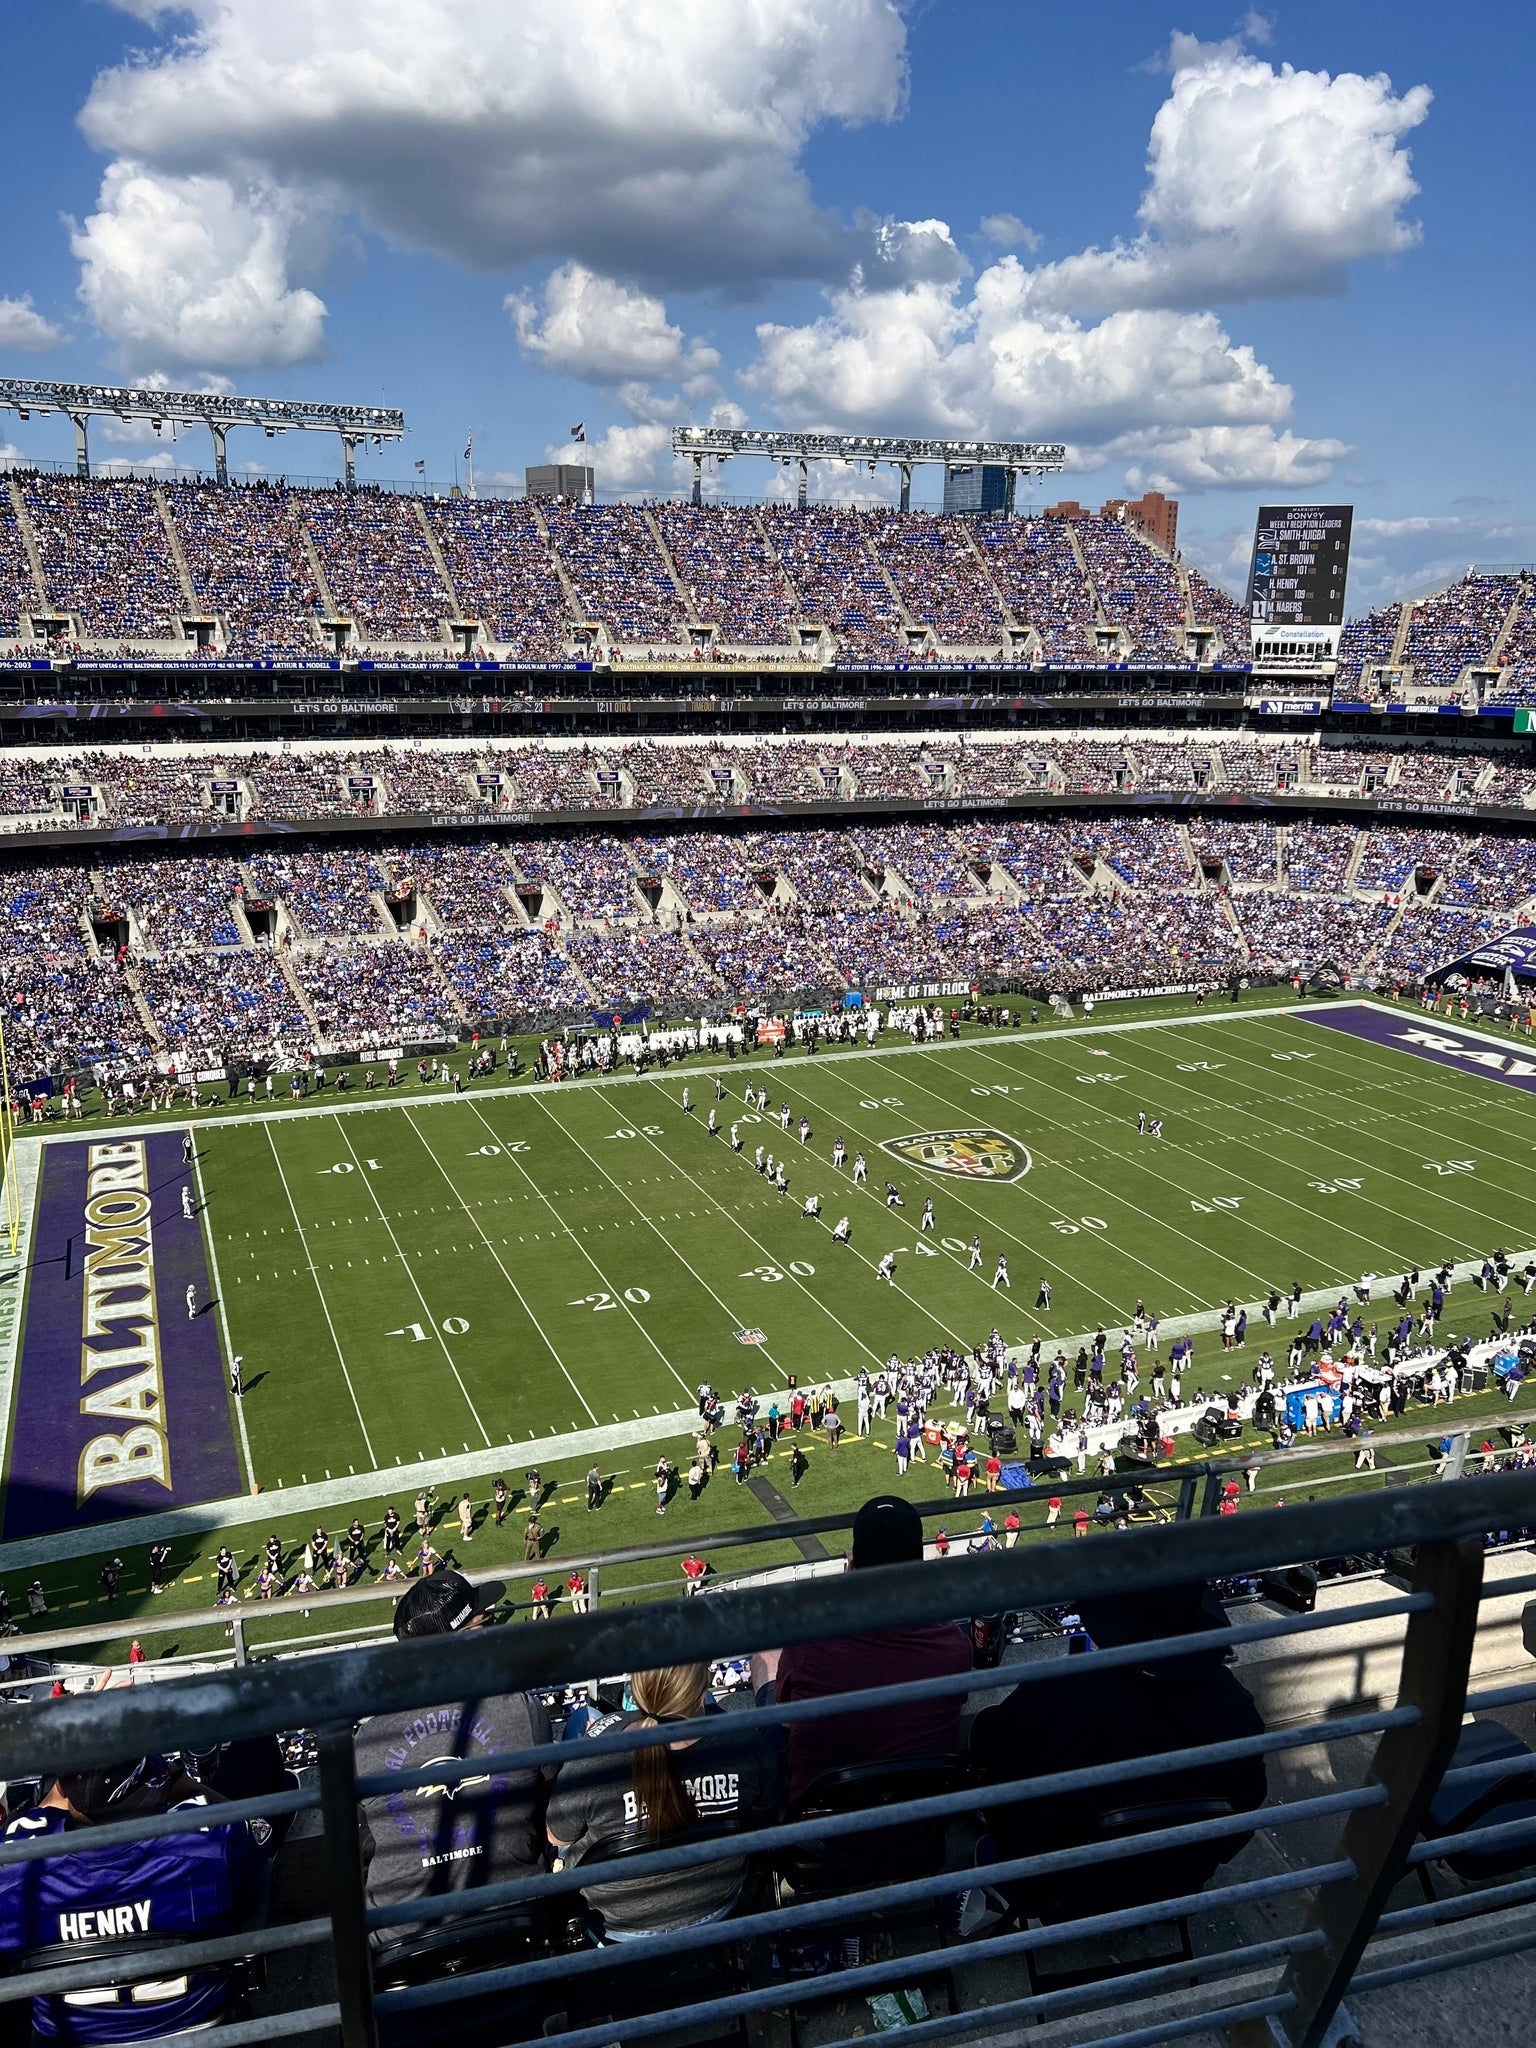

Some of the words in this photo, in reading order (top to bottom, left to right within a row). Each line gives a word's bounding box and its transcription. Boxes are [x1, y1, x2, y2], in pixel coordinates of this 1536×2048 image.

[1287, 512, 1325, 520] BONVOY
[1269, 520, 1289, 529] WEEKLY
[1290, 520, 1318, 529] RECEPTION
[1319, 520, 1342, 528] LEADERS
[1279, 529, 1326, 540] SMITH-NJIGBA
[1275, 541, 1280, 551] 9
[1299, 541, 1310, 551] 101
[1335, 540, 1340, 550] 0
[1271, 554, 1278, 565] A.
[1278, 554, 1289, 565] ST.
[1289, 554, 1315, 565] BROWN
[1273, 566, 1278, 575] 9
[1296, 565, 1307, 575] 101
[1332, 565, 1338, 575] 0
[1269, 579, 1276, 589] H.
[1276, 578, 1299, 589] HENRY
[1330, 590, 1335, 599] 0
[1266, 602, 1276, 612] M.
[1277, 602, 1303, 613] NABERS
[1329, 613, 1332, 623] 1
[293, 704, 320, 713] LET'S
[323, 704, 338, 713] GO
[341, 703, 398, 713] BALTIMORE!
[482, 702, 490, 713] 13
[534, 702, 543, 713] 23
[596, 702, 613, 713] 12:11
[614, 702, 627, 712] QTR
[691, 702, 715, 711] TIMEOUT
[720, 702, 734, 712] 0:17
[783, 702, 804, 710] LET'S
[821, 701, 867, 710] BALTIMORE!
[1156, 699, 1206, 707] BALTIMORE!
[1284, 702, 1314, 711] merritt
[923, 800, 946, 809] LET'S
[947, 800, 959, 808] GO
[962, 798, 1008, 808] BALTIMORE!
[1377, 801, 1403, 810] LET'S
[1405, 802, 1420, 811] GO
[1422, 804, 1478, 816] BALTIMORE!
[431, 815, 458, 825] LET'S
[460, 815, 475, 824] GO
[478, 813, 533, 824] BALTIMORE!
[908, 985, 920, 998] OF
[923, 984, 939, 997] THE
[942, 981, 971, 996] FLOCK
[1082, 988, 1141, 1002] BALTIMORE'S
[1140, 984, 1187, 997] MARCHING
[360, 1051, 376, 1063] RISE
[377, 1047, 403, 1060] CONQUER
[1175, 1060, 1217, 1074] 20
[177, 1072, 196, 1085] RISE
[196, 1068, 226, 1083] CONQUER
[1075, 1072, 1121, 1085] 30
[970, 1085, 1013, 1097] 40
[859, 1097, 905, 1111] 50
[615, 1125, 665, 1140] 30
[893, 1131, 987, 1148] RAVENS
[479, 1140, 532, 1157] 20
[919, 1142, 956, 1160] B
[332, 1158, 384, 1175] 10
[1421, 1158, 1473, 1177] 20
[1306, 1176, 1361, 1195] 30
[1189, 1195, 1241, 1215] 40
[1048, 1215, 1108, 1236] 50
[914, 1236, 967, 1257] 40
[753, 1260, 816, 1283] 30
[585, 1287, 651, 1313] 20
[76, 1140, 173, 1510] BALTIMORE
[405, 1316, 470, 1343] 10
[928, 1431, 937, 1440] G
[587, 1713, 623, 1738] RAVENS
[622, 1773, 739, 1821] BMORE
[421, 1845, 483, 1868] BALTIMORE
[59, 1899, 152, 1942] HENRY
